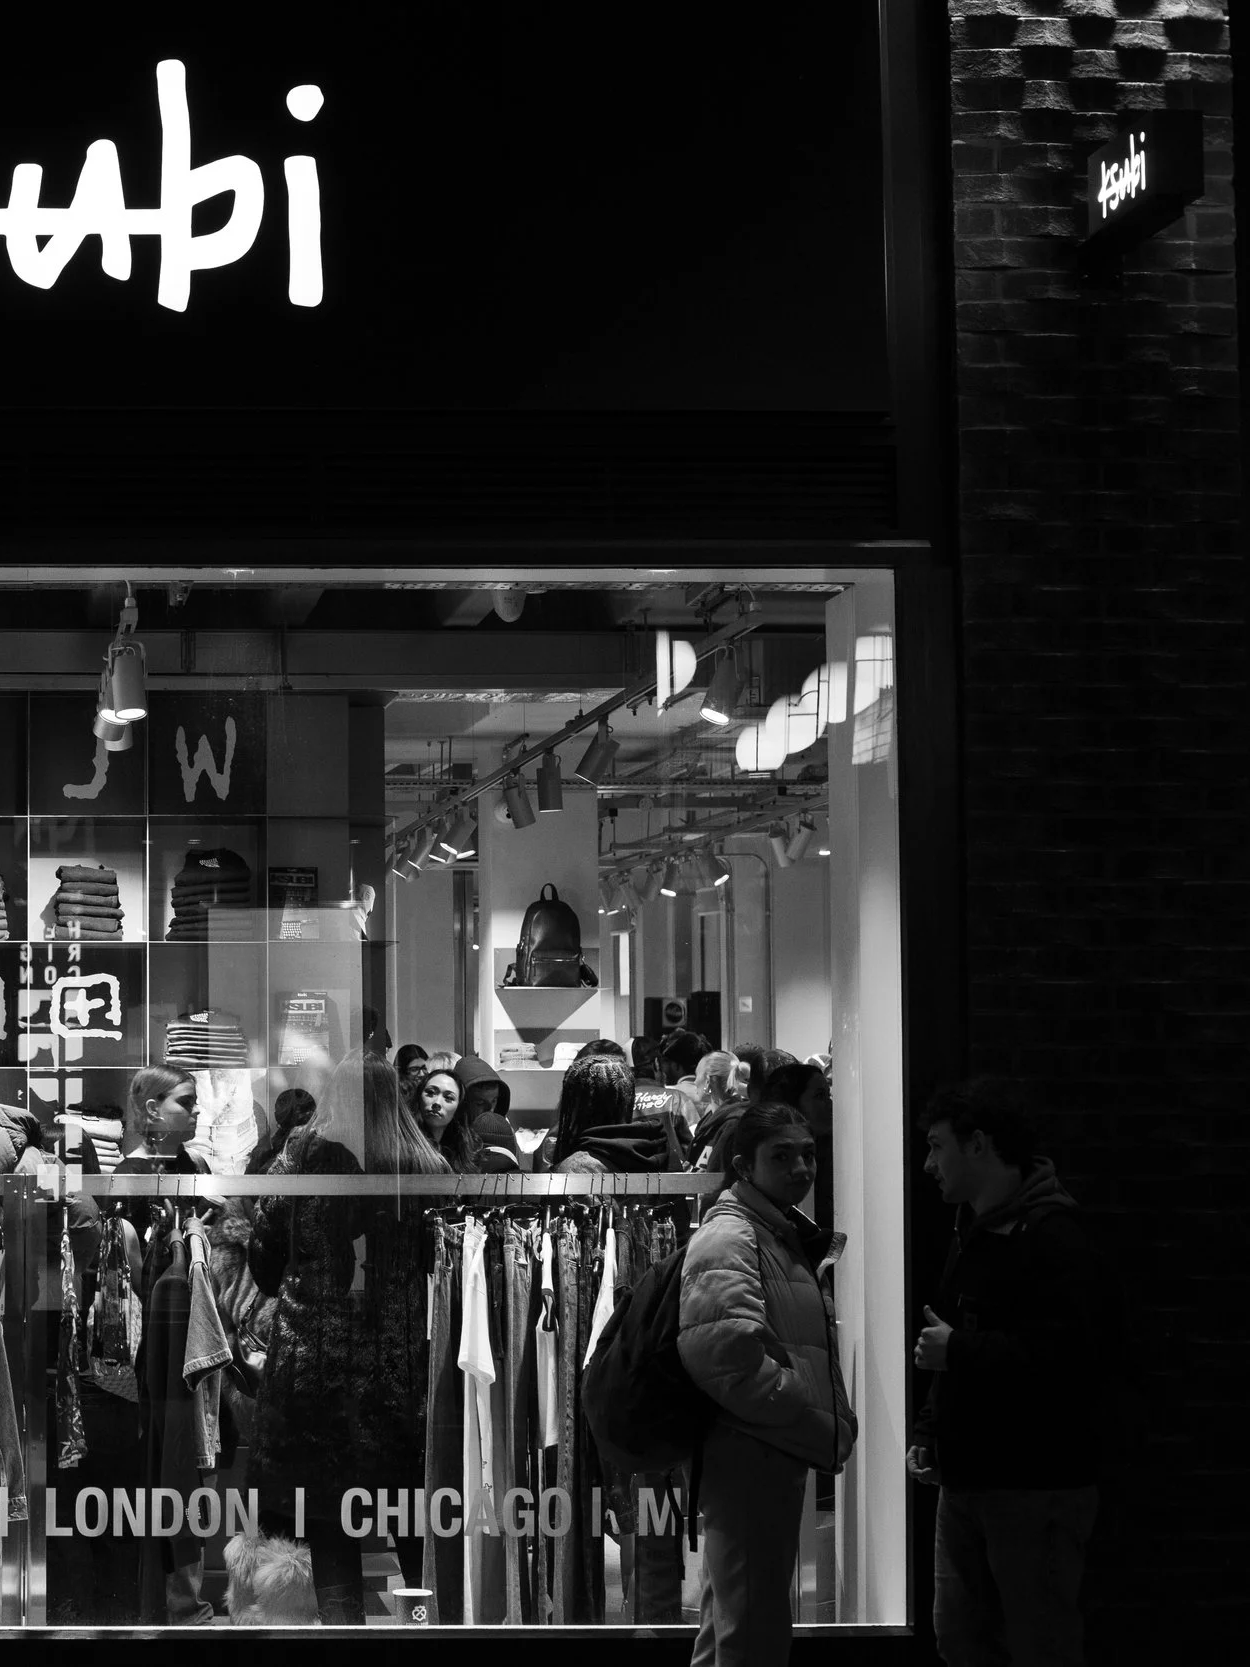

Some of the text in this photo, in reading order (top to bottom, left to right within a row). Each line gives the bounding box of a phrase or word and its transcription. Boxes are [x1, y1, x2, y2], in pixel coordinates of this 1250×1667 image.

[1098, 131, 1146, 218] ksubi
[45, 1487, 257, 1537] LONDON
[340, 1487, 572, 1537] CHICAGO
